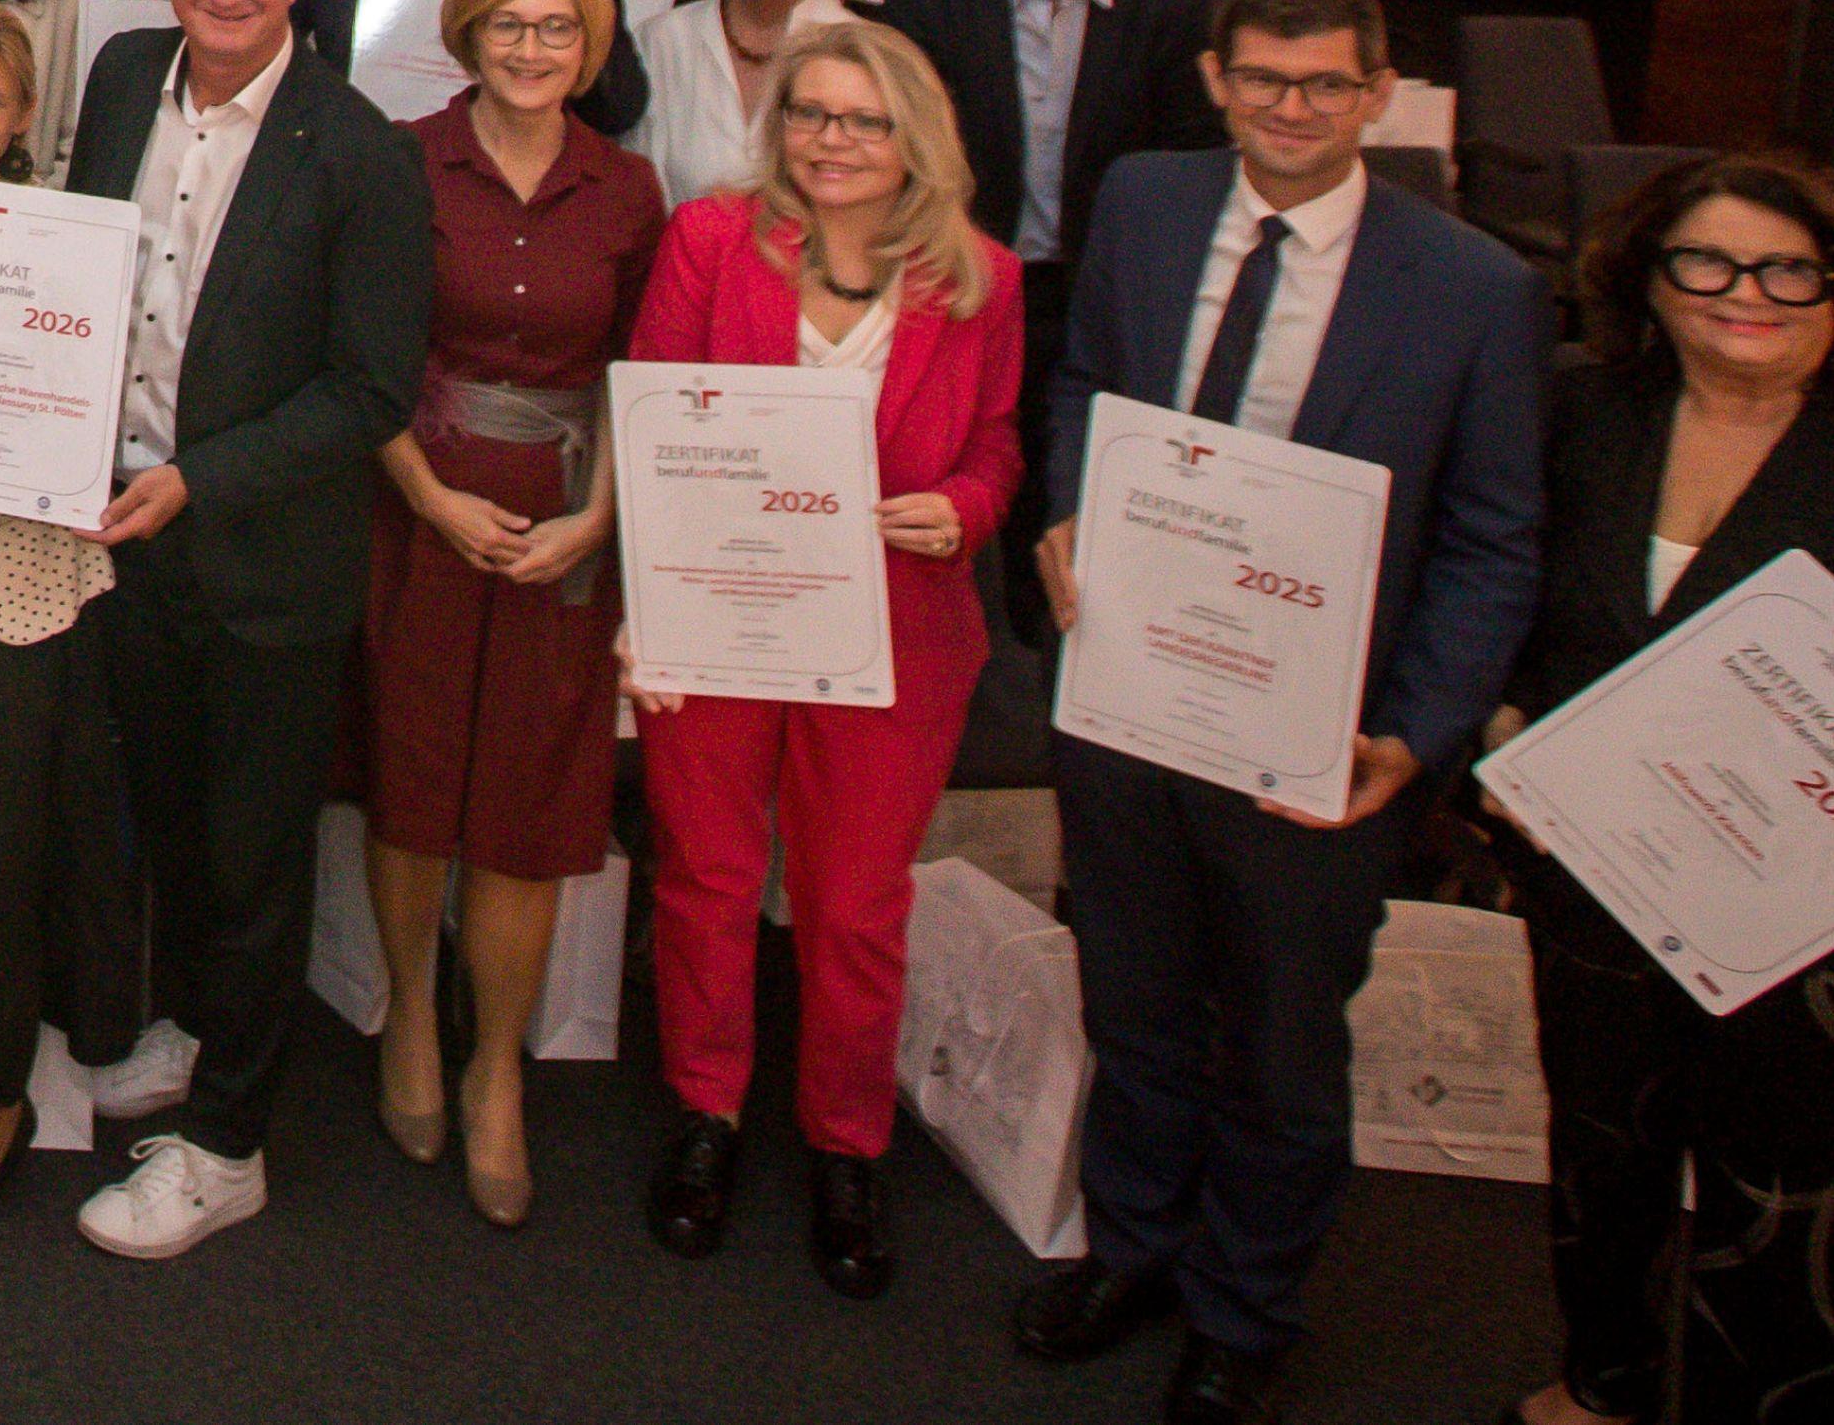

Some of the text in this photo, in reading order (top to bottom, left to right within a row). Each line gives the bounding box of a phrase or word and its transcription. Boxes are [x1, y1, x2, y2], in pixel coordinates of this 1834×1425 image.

[22, 308, 92, 338] 2026
[655, 445, 761, 463] ZERTIFIKAT
[761, 490, 841, 515] 2026
[1127, 487, 1249, 532] ZERTIFIKAT
[1235, 564, 1326, 609] 2025
[1792, 770, 1834, 816] 20
